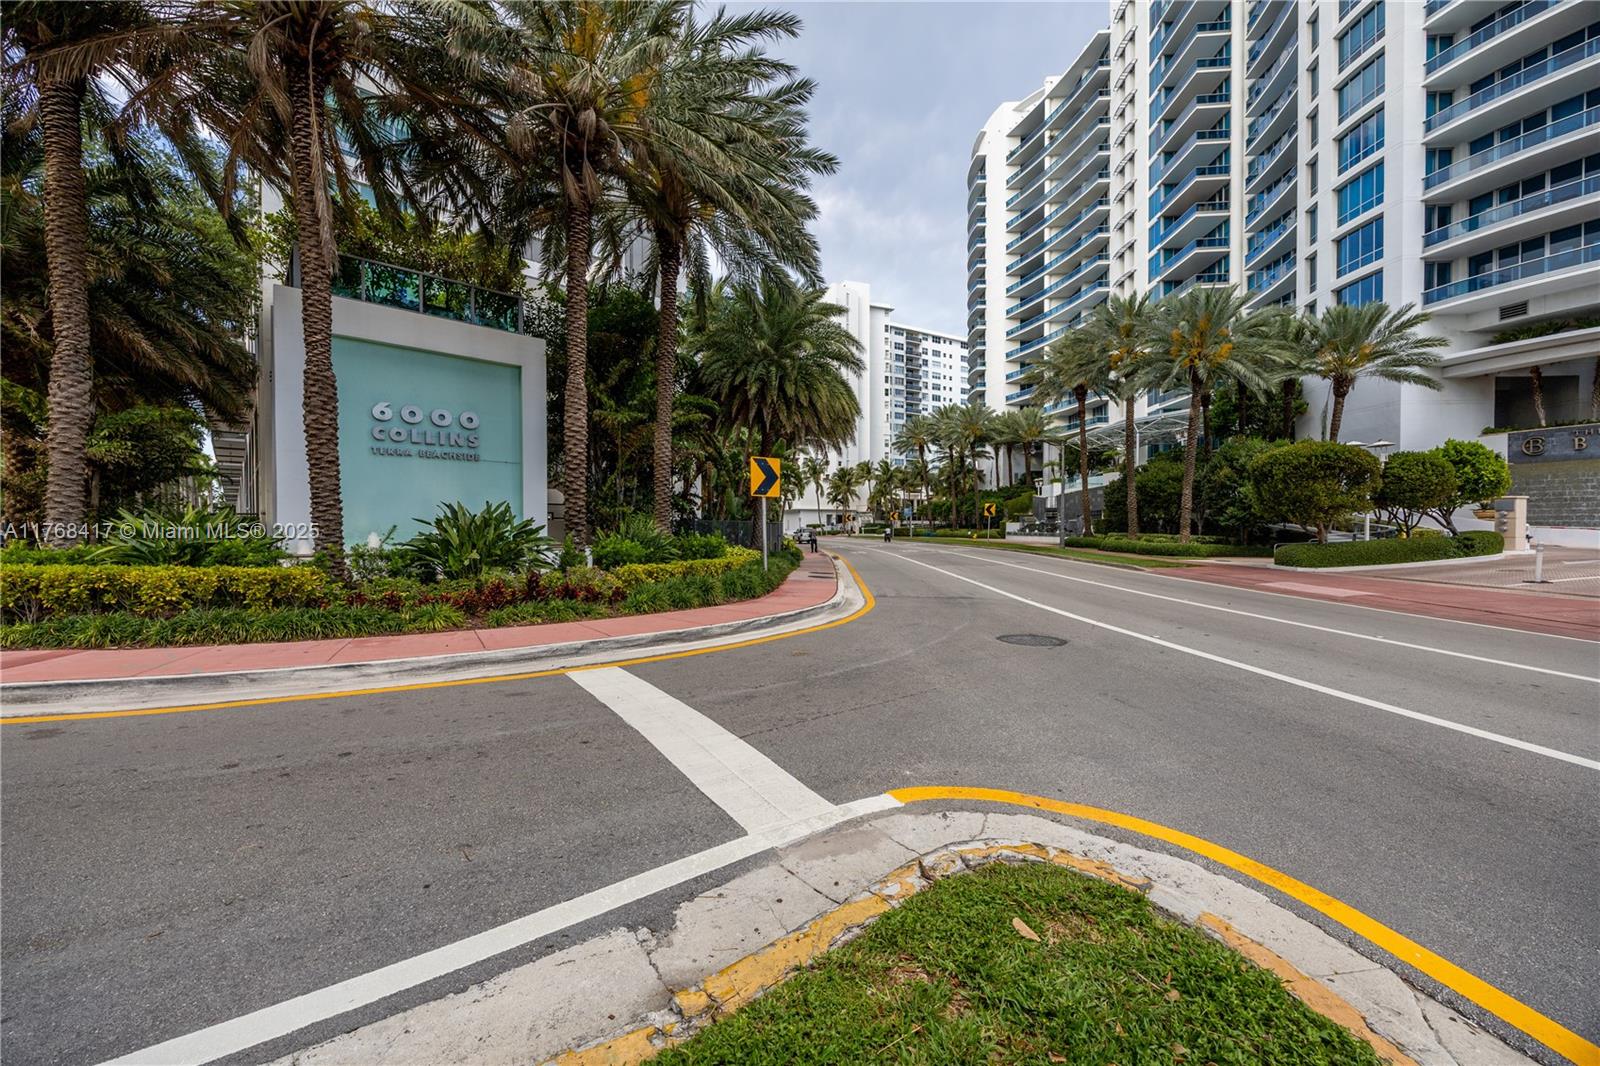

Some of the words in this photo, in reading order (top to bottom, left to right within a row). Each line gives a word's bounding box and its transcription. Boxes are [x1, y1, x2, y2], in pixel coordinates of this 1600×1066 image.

[371, 401, 480, 430] 6000
[372, 424, 480, 448] COLLINS
[1573, 428, 1600, 436] TH
[418, 449, 480, 462] BEACHSIDE
